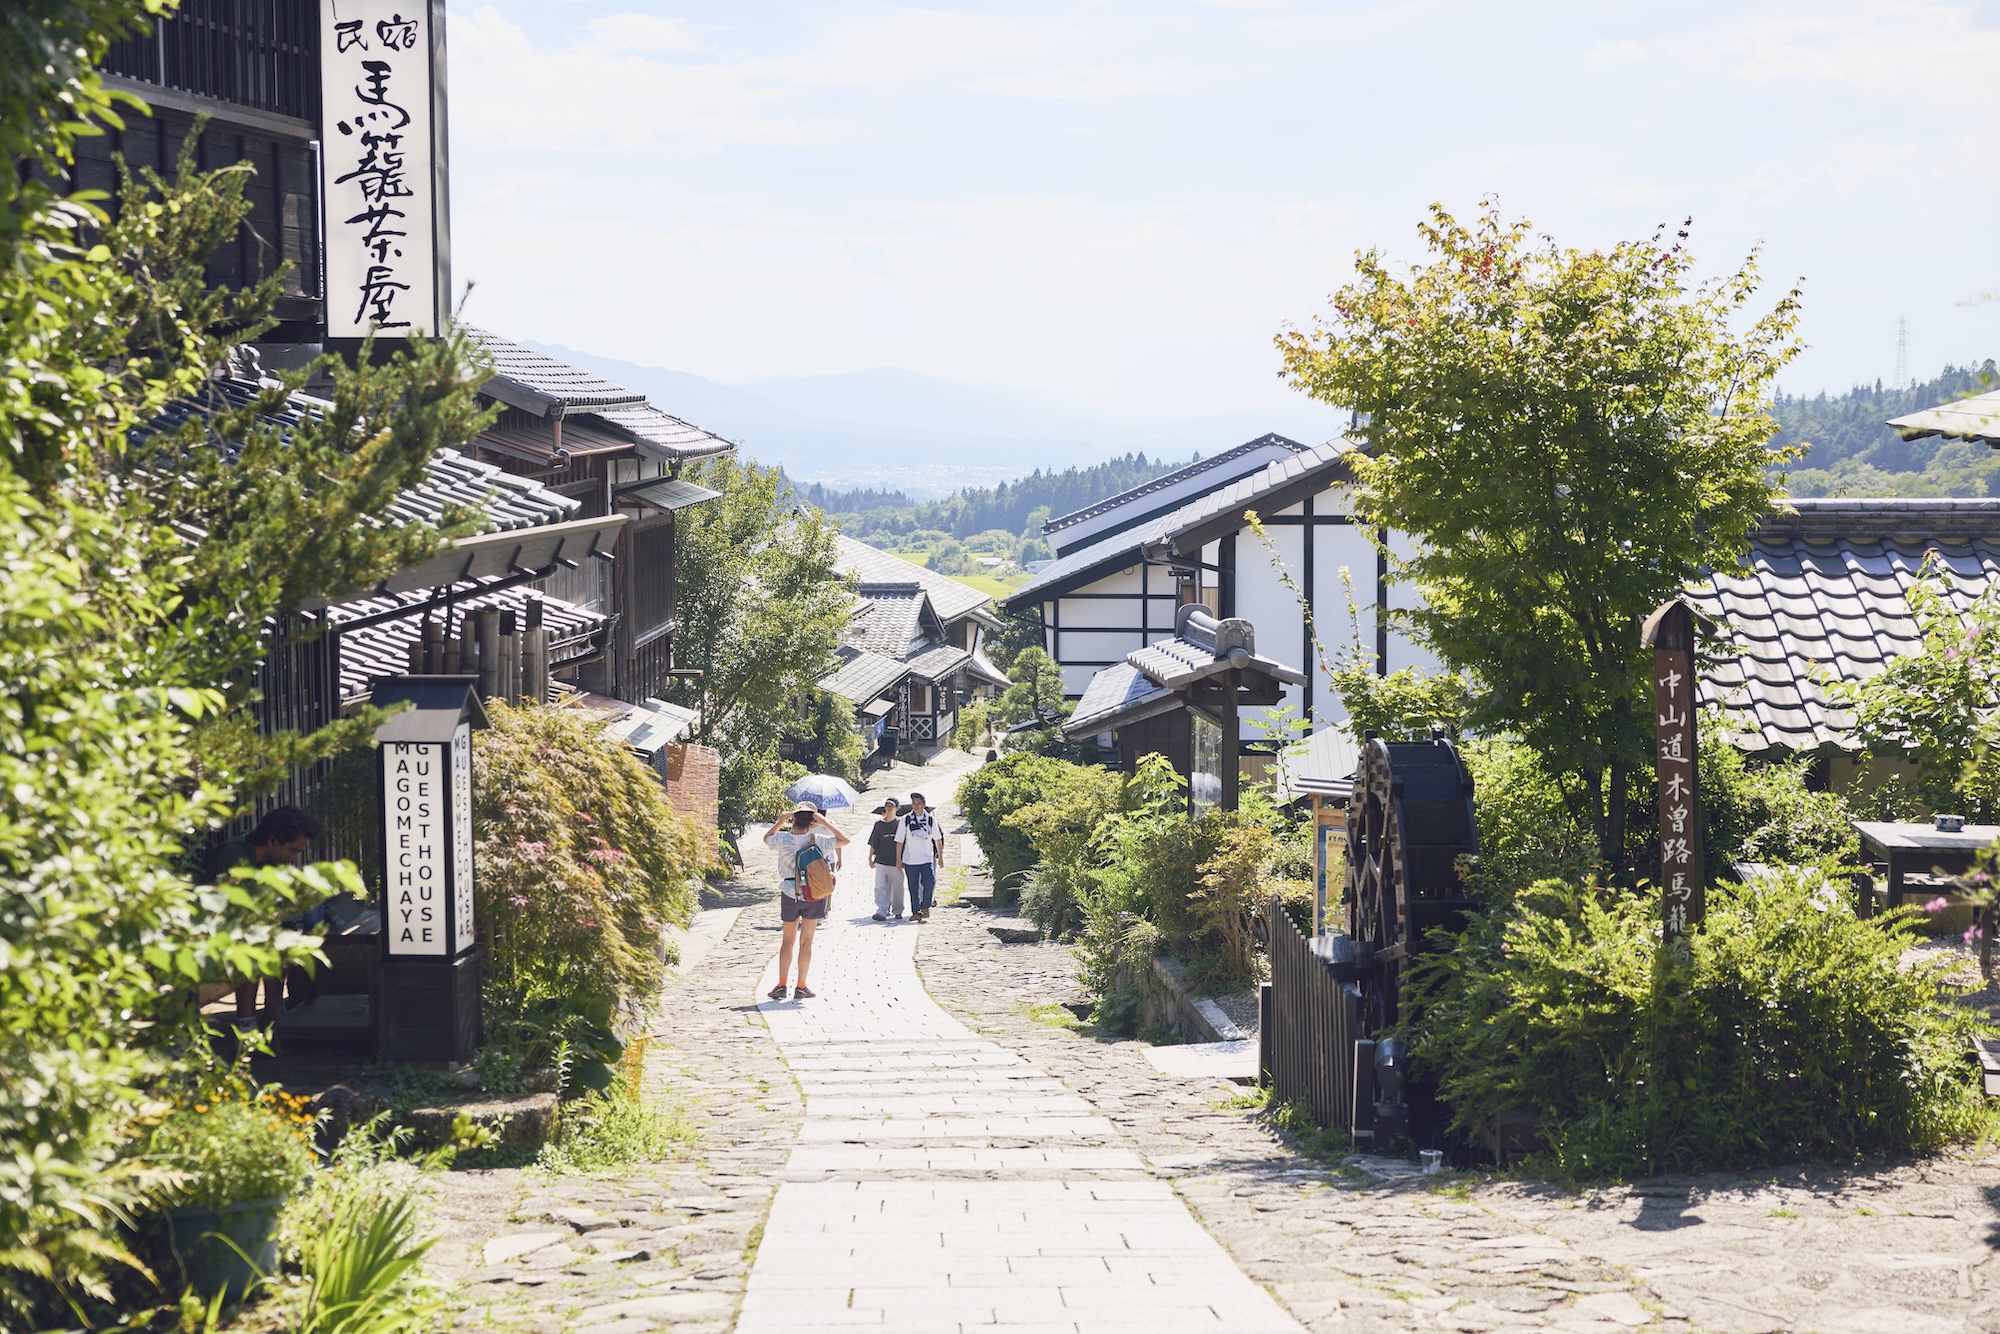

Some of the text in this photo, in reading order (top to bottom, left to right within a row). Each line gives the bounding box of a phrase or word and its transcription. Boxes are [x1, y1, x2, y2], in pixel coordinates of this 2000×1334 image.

[334, 14, 418, 53] 民宿
[334, 60, 414, 329] 馬籠茶屋
[395, 743, 414, 942] MAGOMECHAYA
[416, 743, 433, 942] GUESTHOUSE
[454, 736, 465, 938] MAGOMECHAYA
[460, 735, 471, 935] GUESTHOUSE
